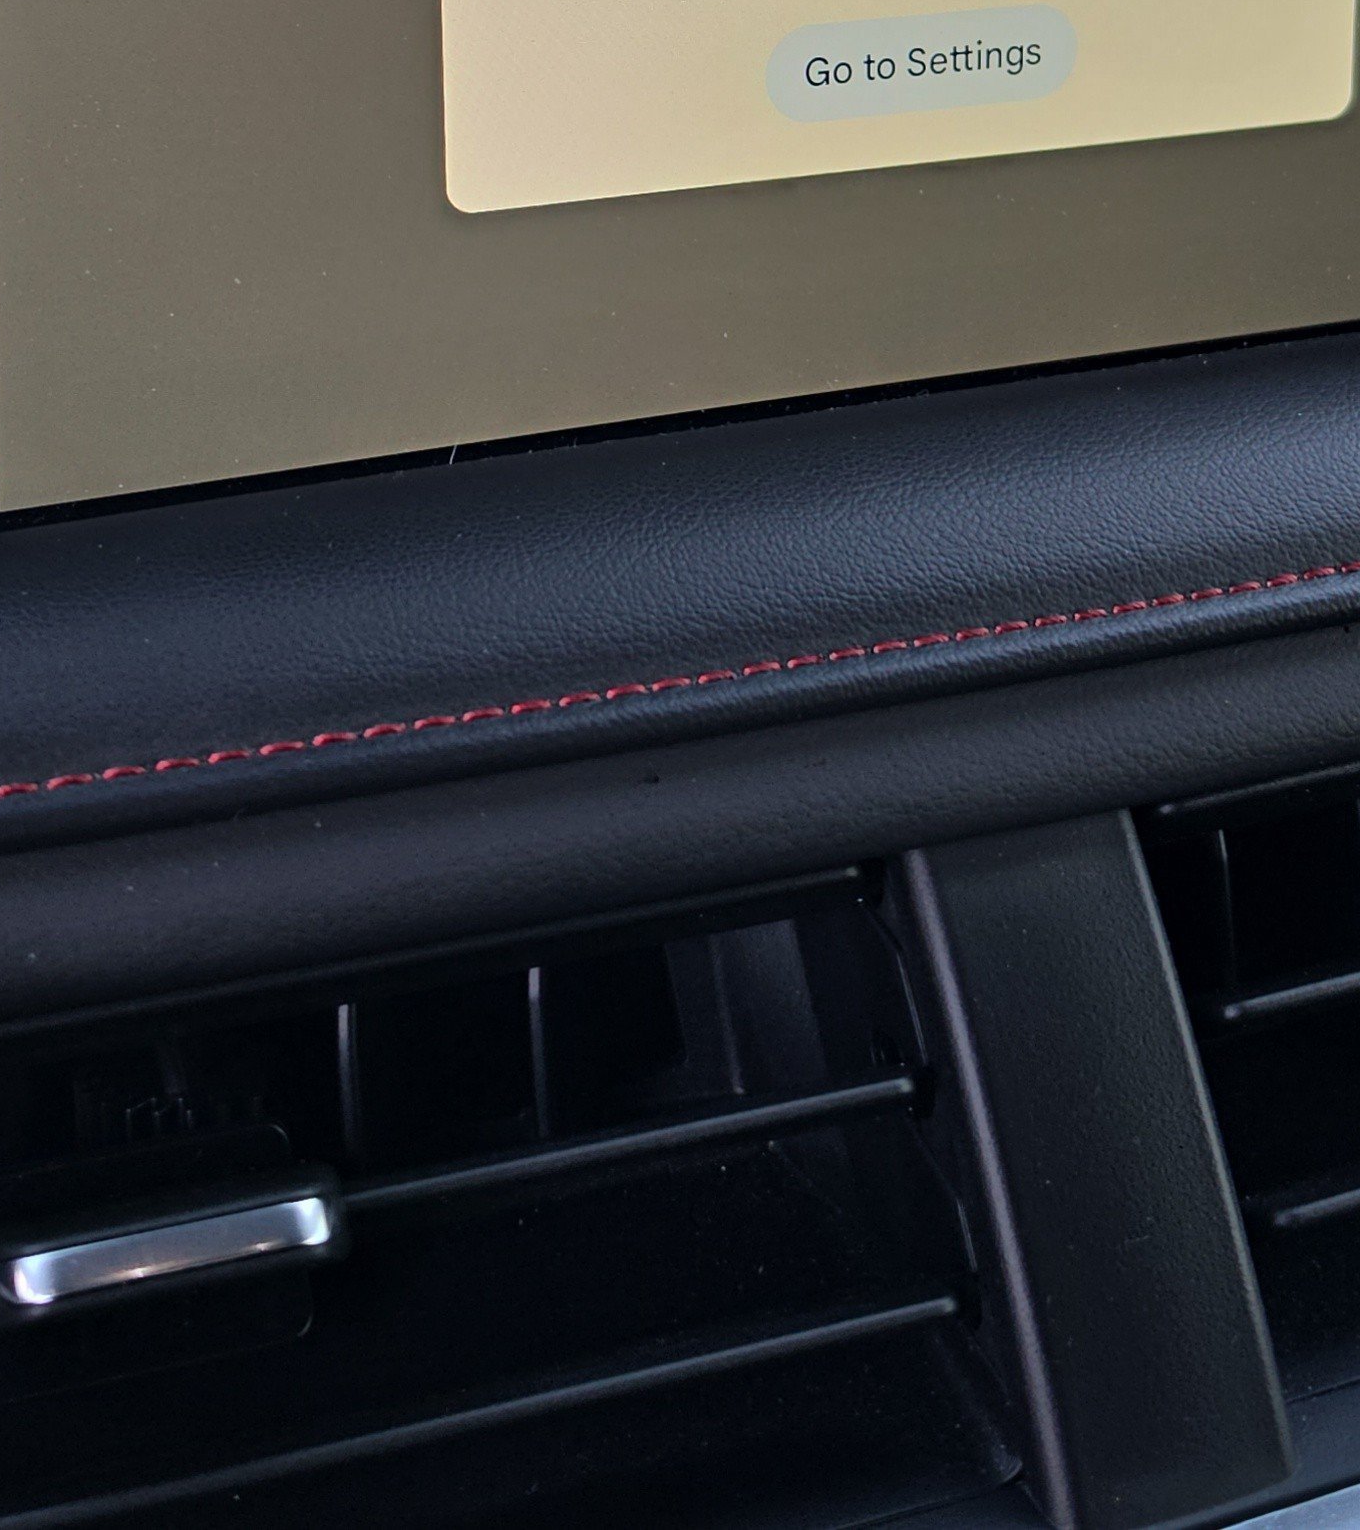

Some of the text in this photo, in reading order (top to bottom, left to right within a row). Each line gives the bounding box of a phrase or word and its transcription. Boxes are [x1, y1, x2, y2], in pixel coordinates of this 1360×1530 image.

[803, 39, 1042, 87] Go to Settings
